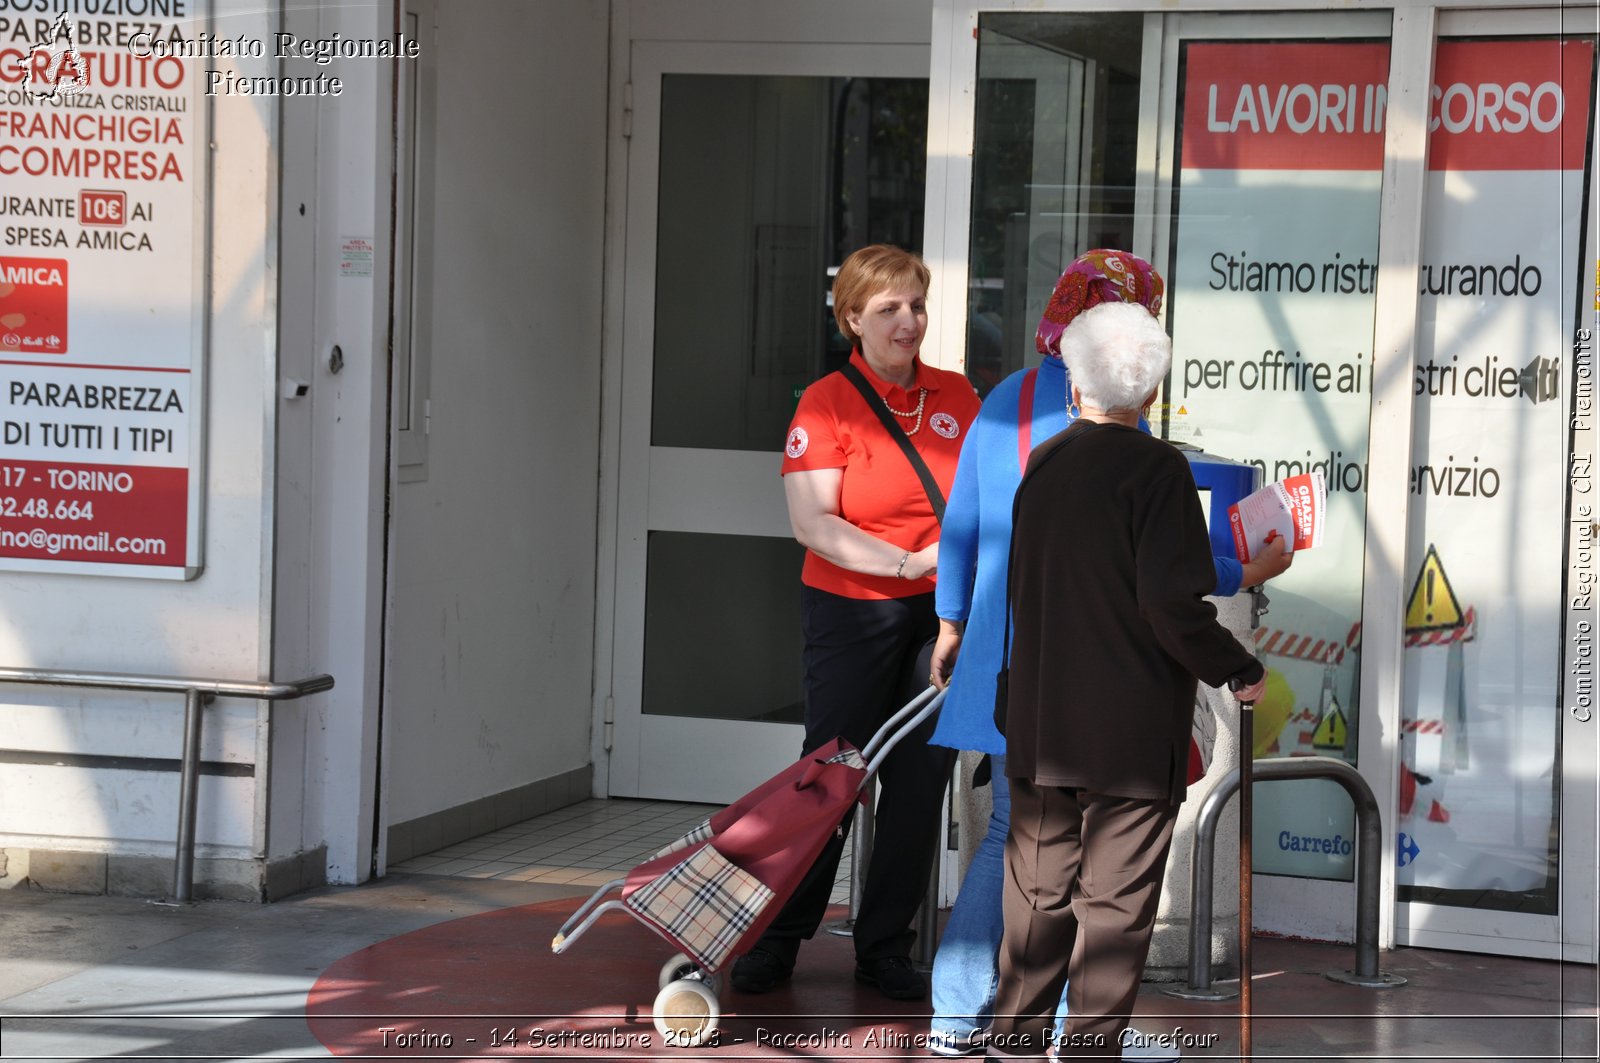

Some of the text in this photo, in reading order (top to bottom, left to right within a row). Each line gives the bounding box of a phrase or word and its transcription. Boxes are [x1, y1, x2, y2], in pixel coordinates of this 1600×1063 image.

[0, 17, 186, 48] PARABREZZA
[0, 48, 185, 90] GRATUITO
[111, 94, 186, 113] CRISTALLI
[1207, 83, 1357, 134] LAVORI
[0, 111, 184, 145] FRANCHIGIA
[0, 145, 184, 182] COMPRESA
[83, 198, 121, 220] 10€
[131, 202, 153, 222] AI
[5, 226, 153, 252] SPESA AMICA
[1209, 250, 1316, 294] Stiamo
[1183, 358, 1235, 399] per
[1239, 350, 1332, 393] offrire
[1337, 352, 1362, 393] ai
[10, 381, 184, 413] PARABREZZA
[4, 421, 173, 453] DI TUTTI I TIPI
[48, 469, 134, 493] TORINO
[0, 497, 94, 520] 2.48.664
